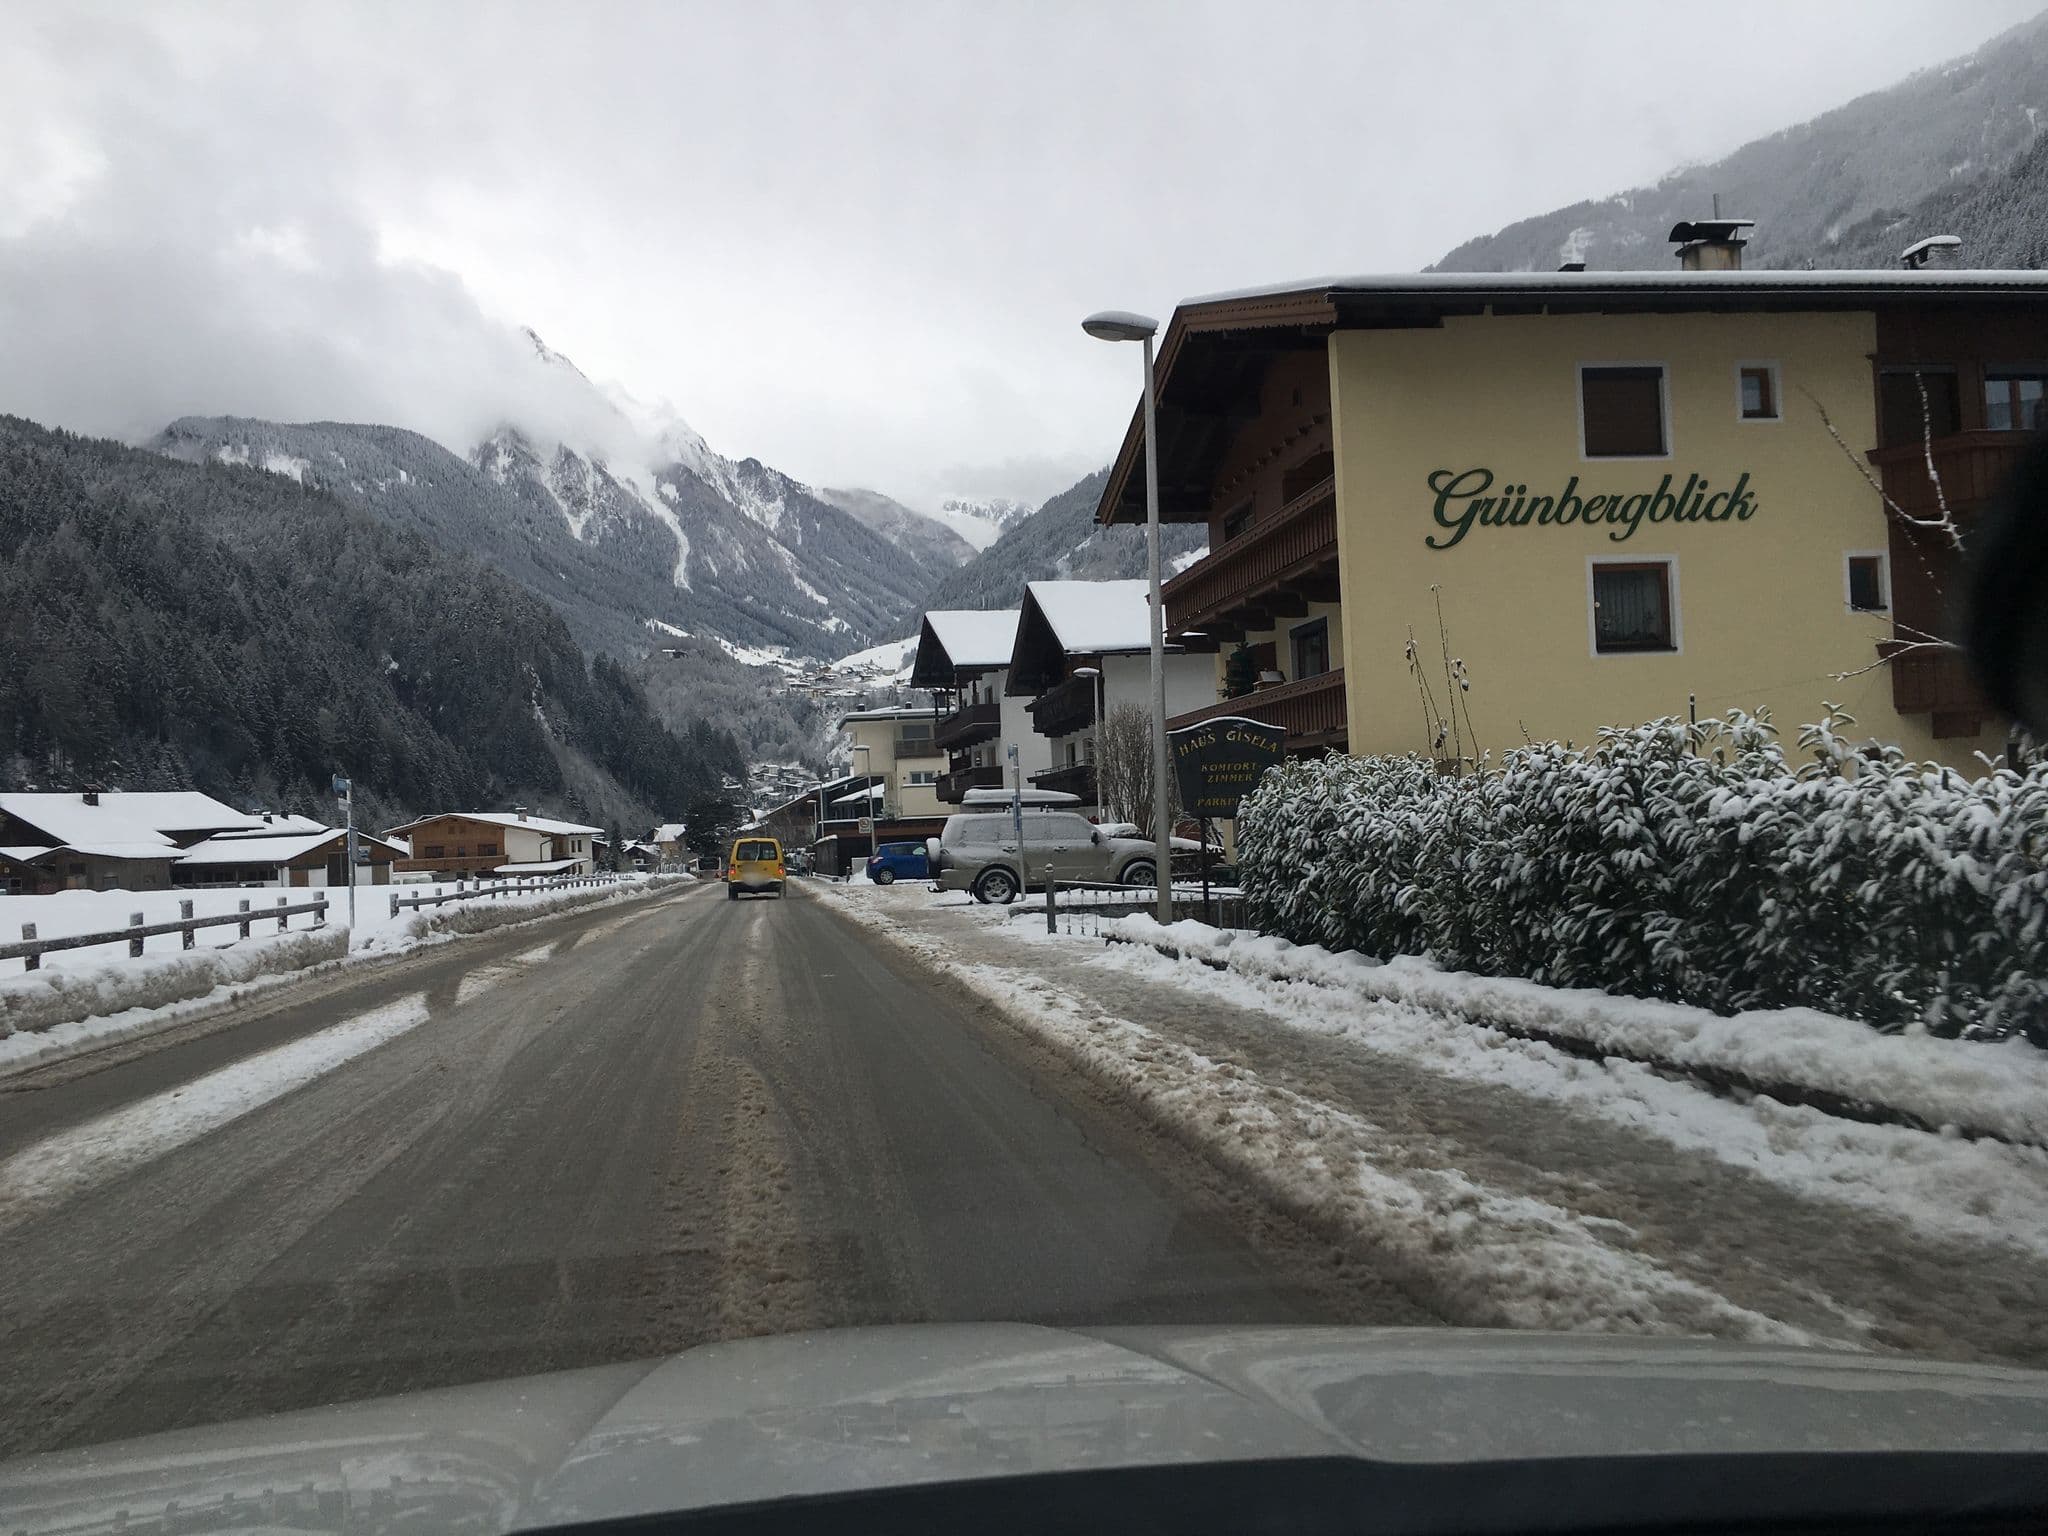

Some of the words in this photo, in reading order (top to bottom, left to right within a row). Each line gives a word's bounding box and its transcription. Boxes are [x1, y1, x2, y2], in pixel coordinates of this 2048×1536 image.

[1425, 468, 1758, 549] Grünbergblick
[1179, 733, 1216, 757] HAUS
[1226, 730, 1278, 753] GISELA
[1207, 773, 1253, 783] ZIMMER
